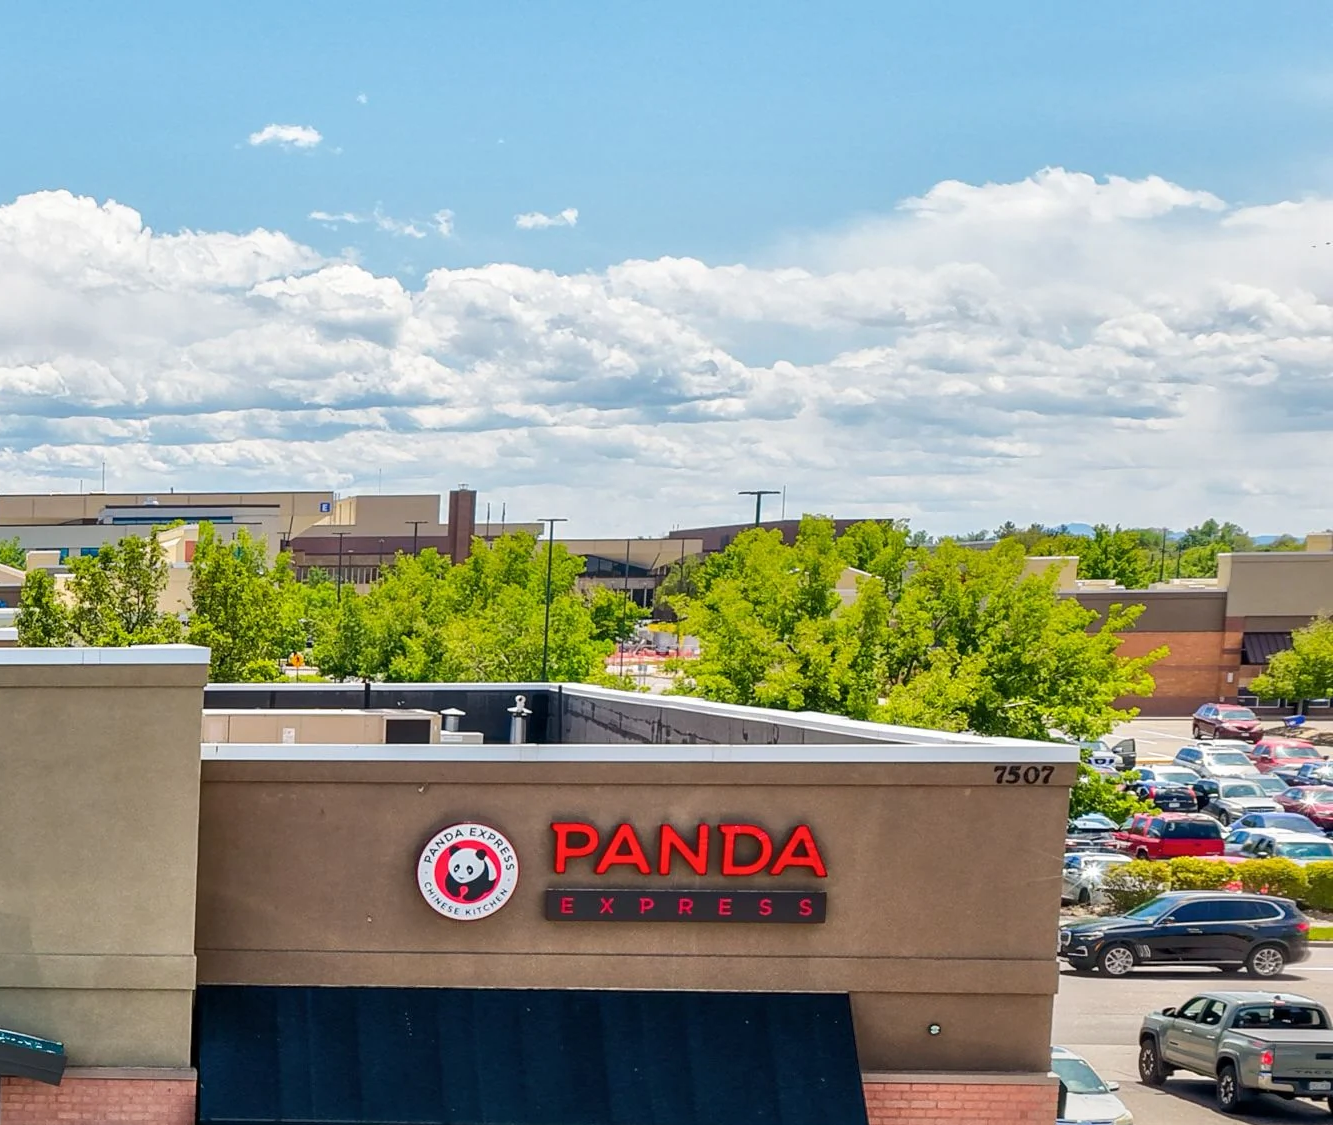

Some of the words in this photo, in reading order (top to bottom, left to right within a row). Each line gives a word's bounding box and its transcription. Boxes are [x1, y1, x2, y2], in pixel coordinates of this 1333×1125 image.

[993, 765, 1055, 785] 7507
[424, 829, 464, 863] PANDA
[469, 827, 515, 871] EXPRESS
[550, 822, 828, 877] PANDA
[424, 881, 461, 916] CHINESE
[465, 888, 508, 916] KITCHEN
[560, 897, 813, 916] EXPRESS
